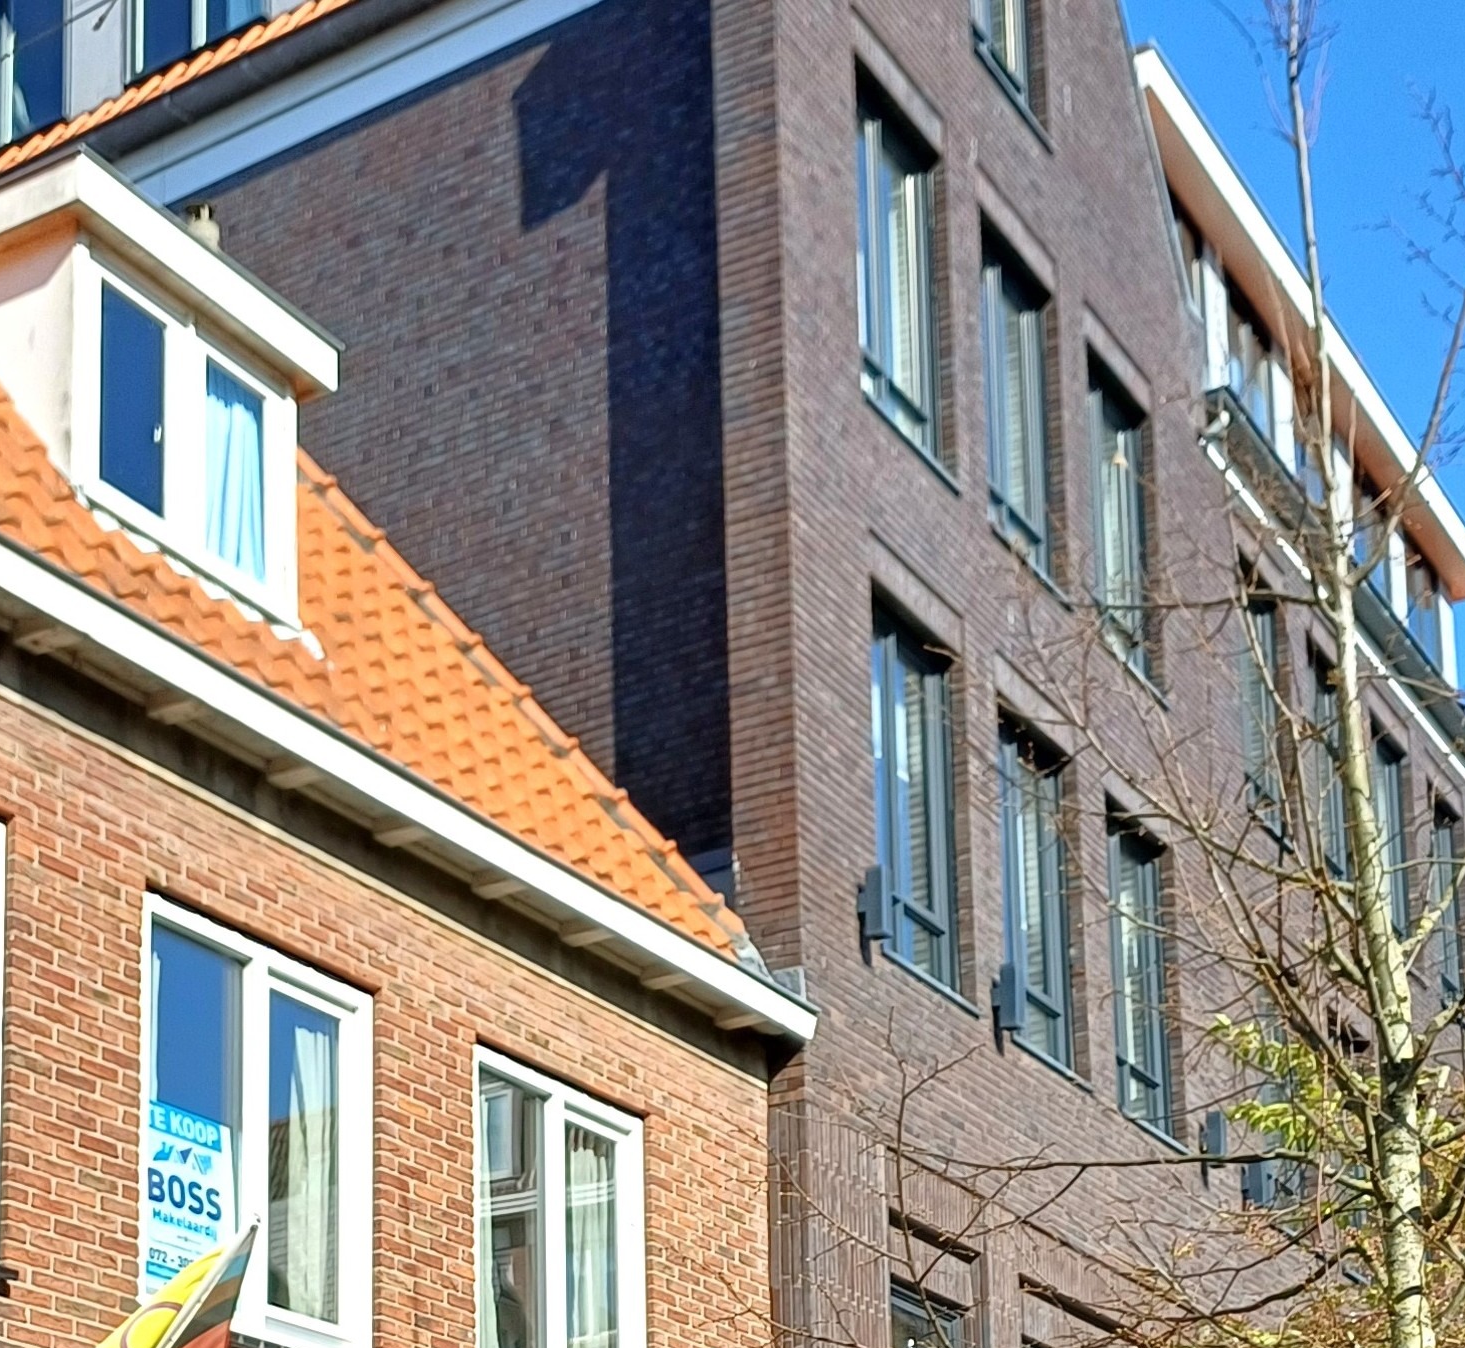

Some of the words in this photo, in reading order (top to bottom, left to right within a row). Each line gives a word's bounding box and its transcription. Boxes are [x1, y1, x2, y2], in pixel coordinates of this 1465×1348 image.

[170, 1111, 219, 1147] KOOP
[148, 1168, 221, 1221] BOSS
[152, 1207, 218, 1242] Makelaardij
